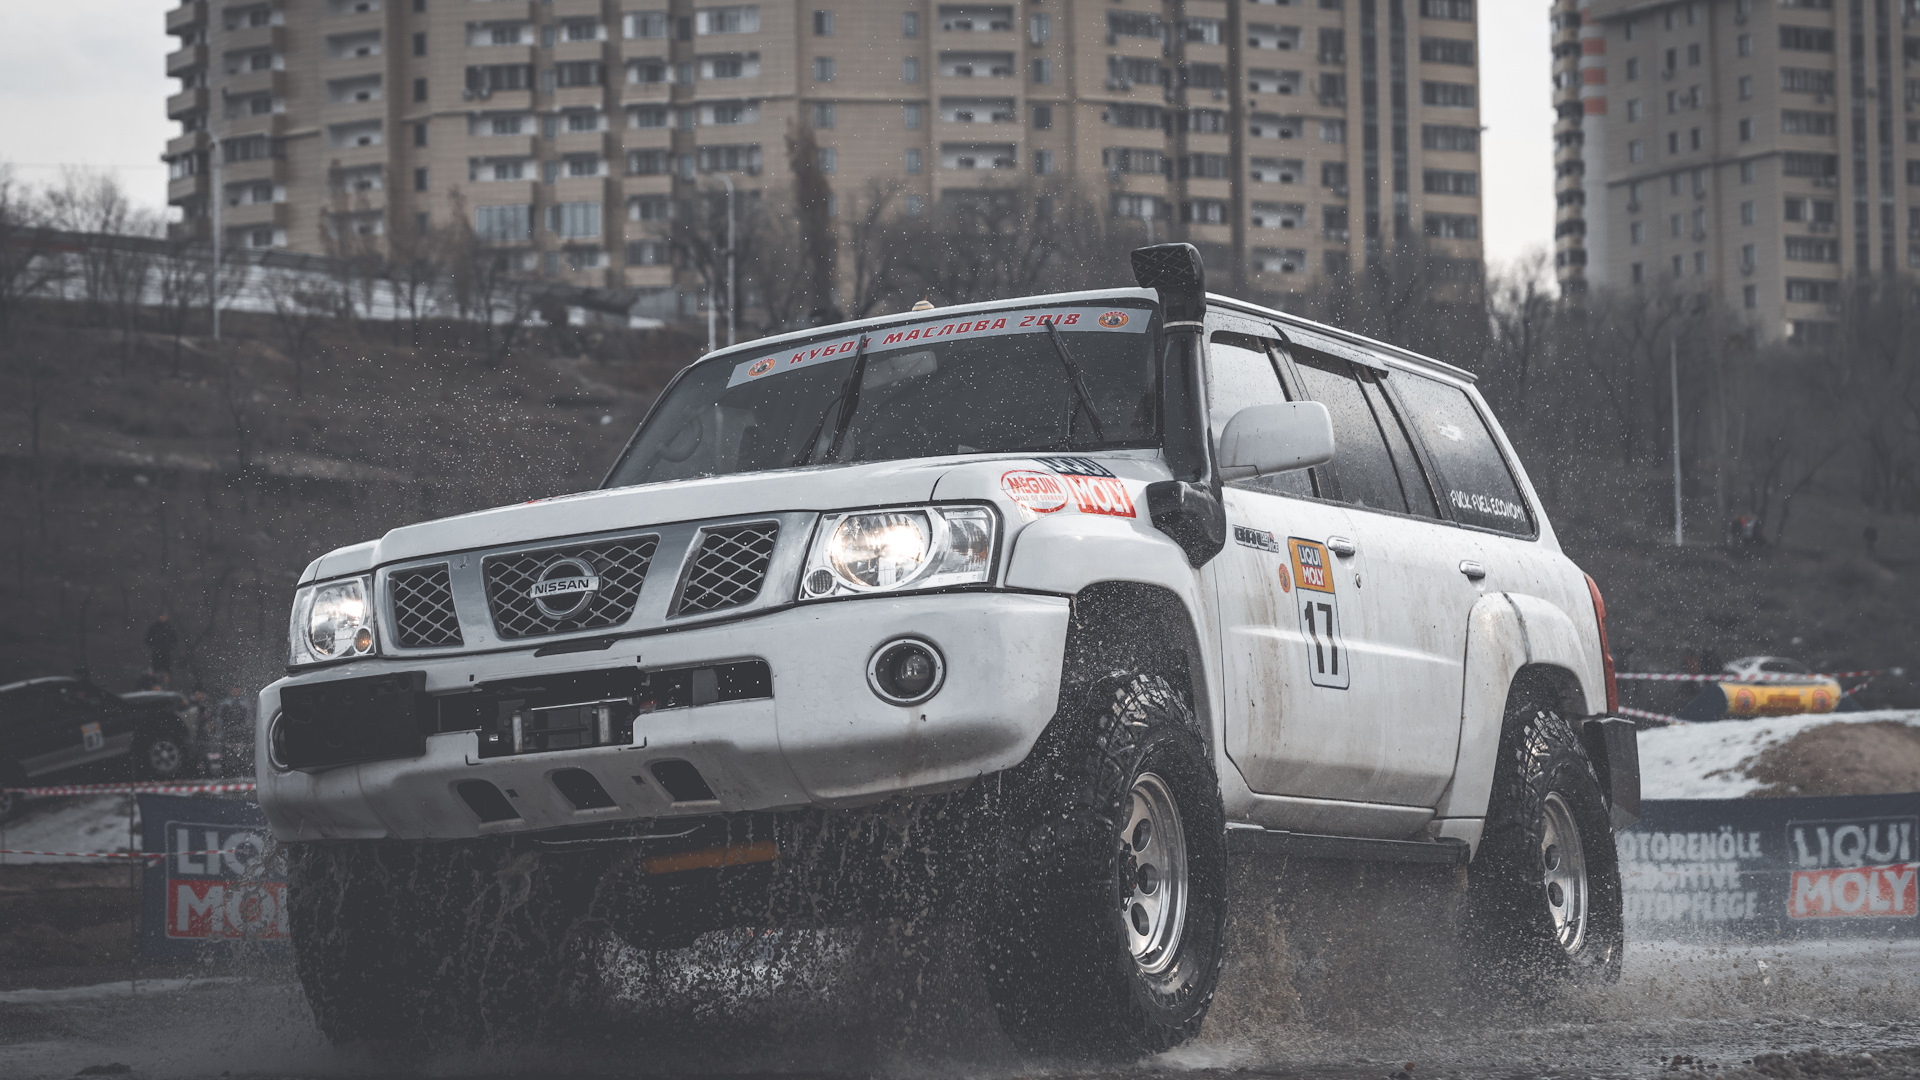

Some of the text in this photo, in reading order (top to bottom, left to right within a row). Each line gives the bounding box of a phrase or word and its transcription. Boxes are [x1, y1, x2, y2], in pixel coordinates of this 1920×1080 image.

[883, 318, 1007, 345] МАСЛОВА
[1019, 313, 1081, 327] 2018
[1067, 476, 1131, 513] MOLY
[1450, 490, 1526, 522] FUCK FUEL ECONOMY
[1298, 546, 1322, 566] LIQUI
[534, 579, 589, 594] NISSAN
[1301, 566, 1325, 586] MOLY
[1304, 601, 1338, 675] 17
[1616, 825, 1763, 861] OTORENÖLE
[1794, 823, 1911, 868] LIQUI
[1795, 871, 1914, 914] MOLY
